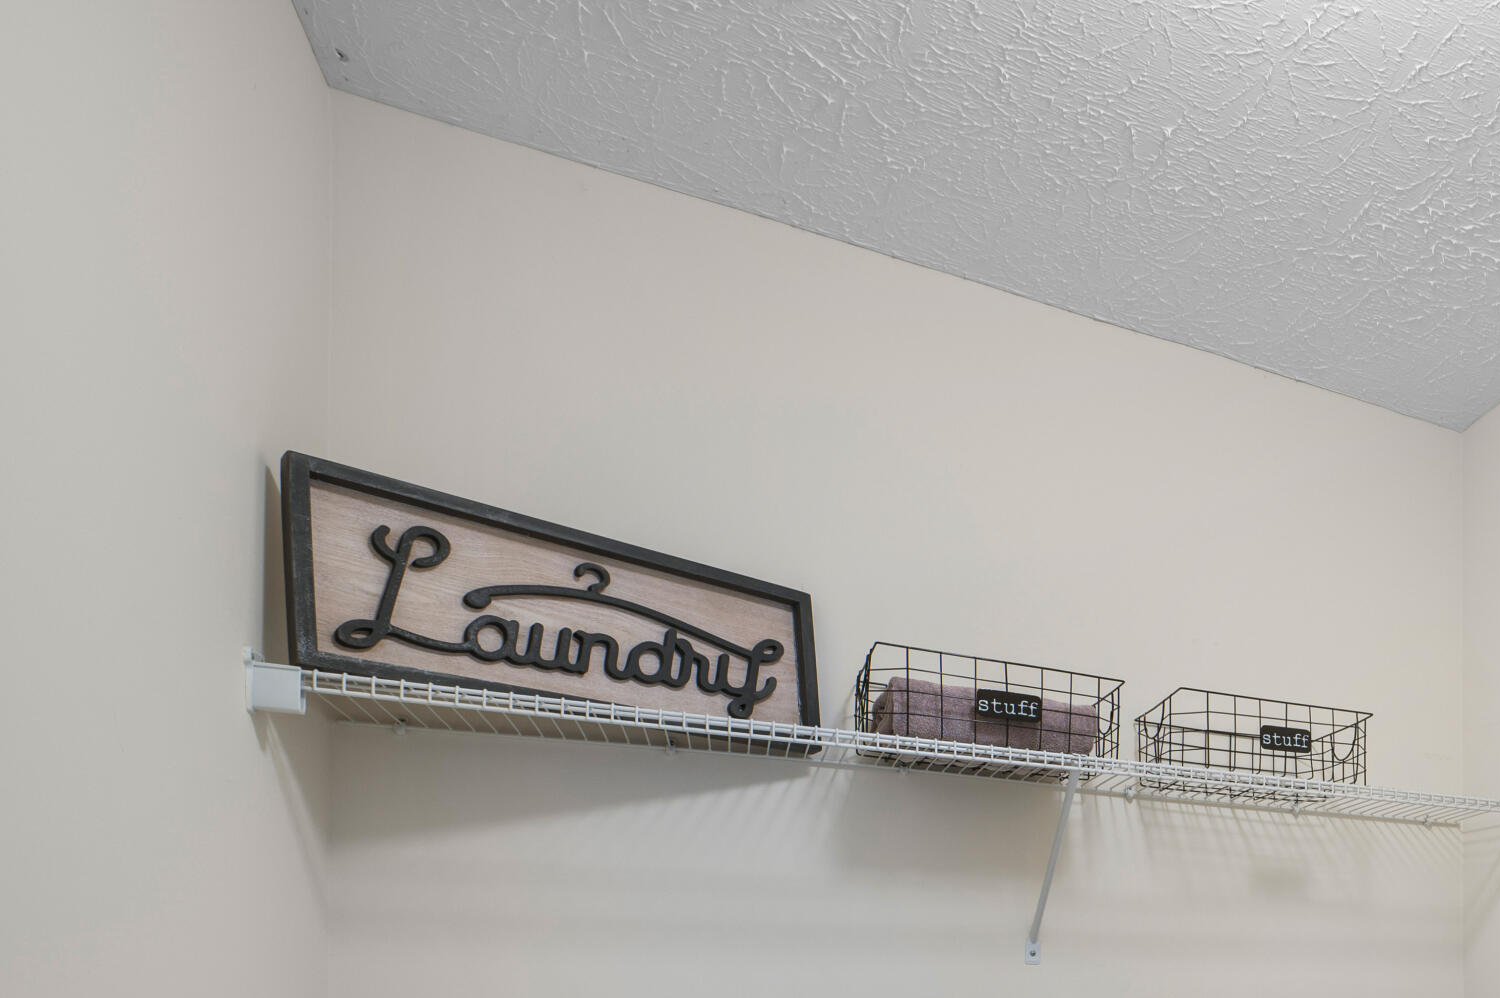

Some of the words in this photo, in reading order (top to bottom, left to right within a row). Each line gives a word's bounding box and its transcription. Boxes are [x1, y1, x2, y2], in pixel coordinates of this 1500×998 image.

[334, 525, 784, 718] Laundry
[978, 698, 1038, 717] stuff
[1262, 732, 1309, 748] stuff
